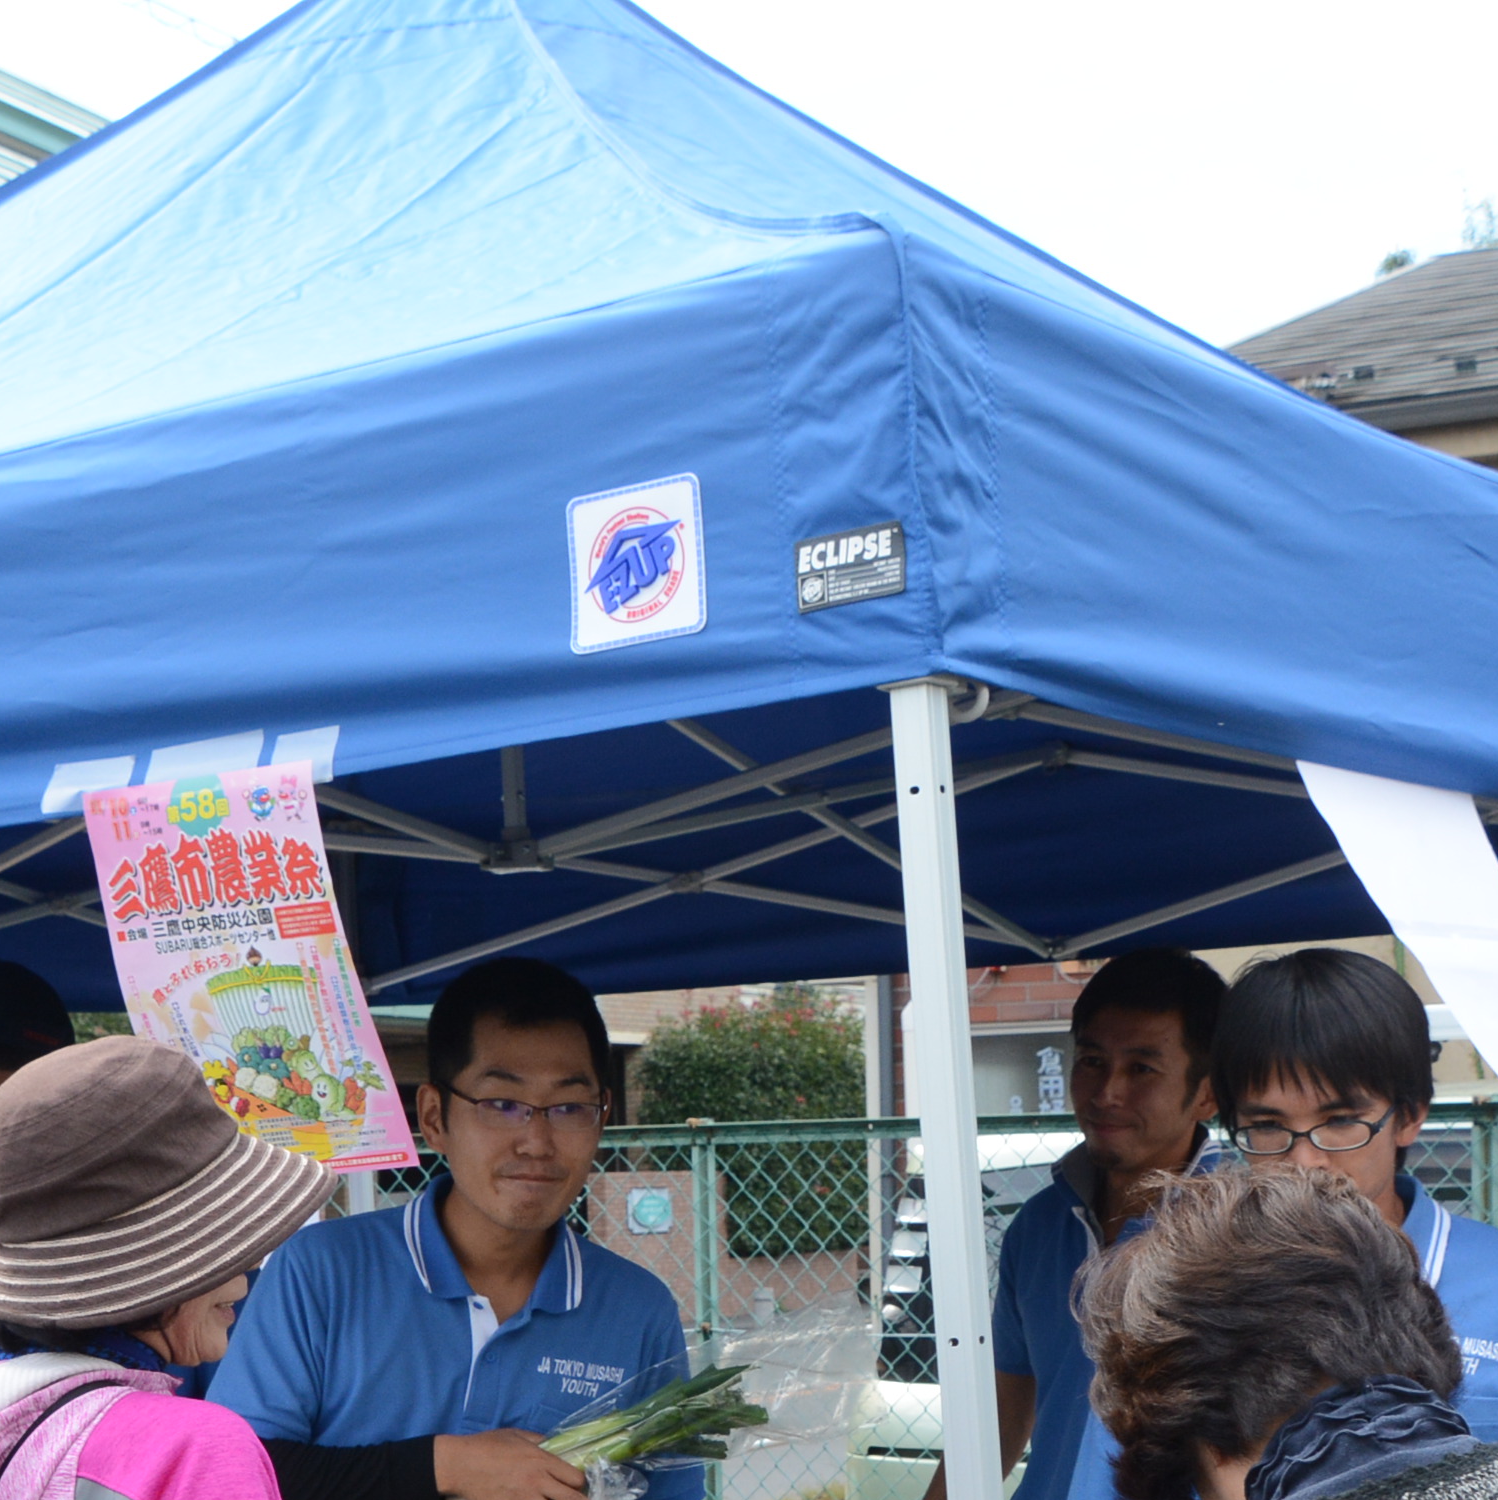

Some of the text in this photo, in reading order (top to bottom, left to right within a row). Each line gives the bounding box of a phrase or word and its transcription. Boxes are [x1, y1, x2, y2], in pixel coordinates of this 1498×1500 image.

[798, 528, 892, 574] ECLIPSE
[166, 789, 231, 825] 第58回
[112, 821, 132, 841] 11
[108, 828, 325, 922] 三鷹市農業祭
[152, 907, 273, 938] 三鷹中央防災公園
[537, 1357, 625, 1384] JA TOKYO MUSASHI
[561, 1377, 599, 1398] YOUTH
